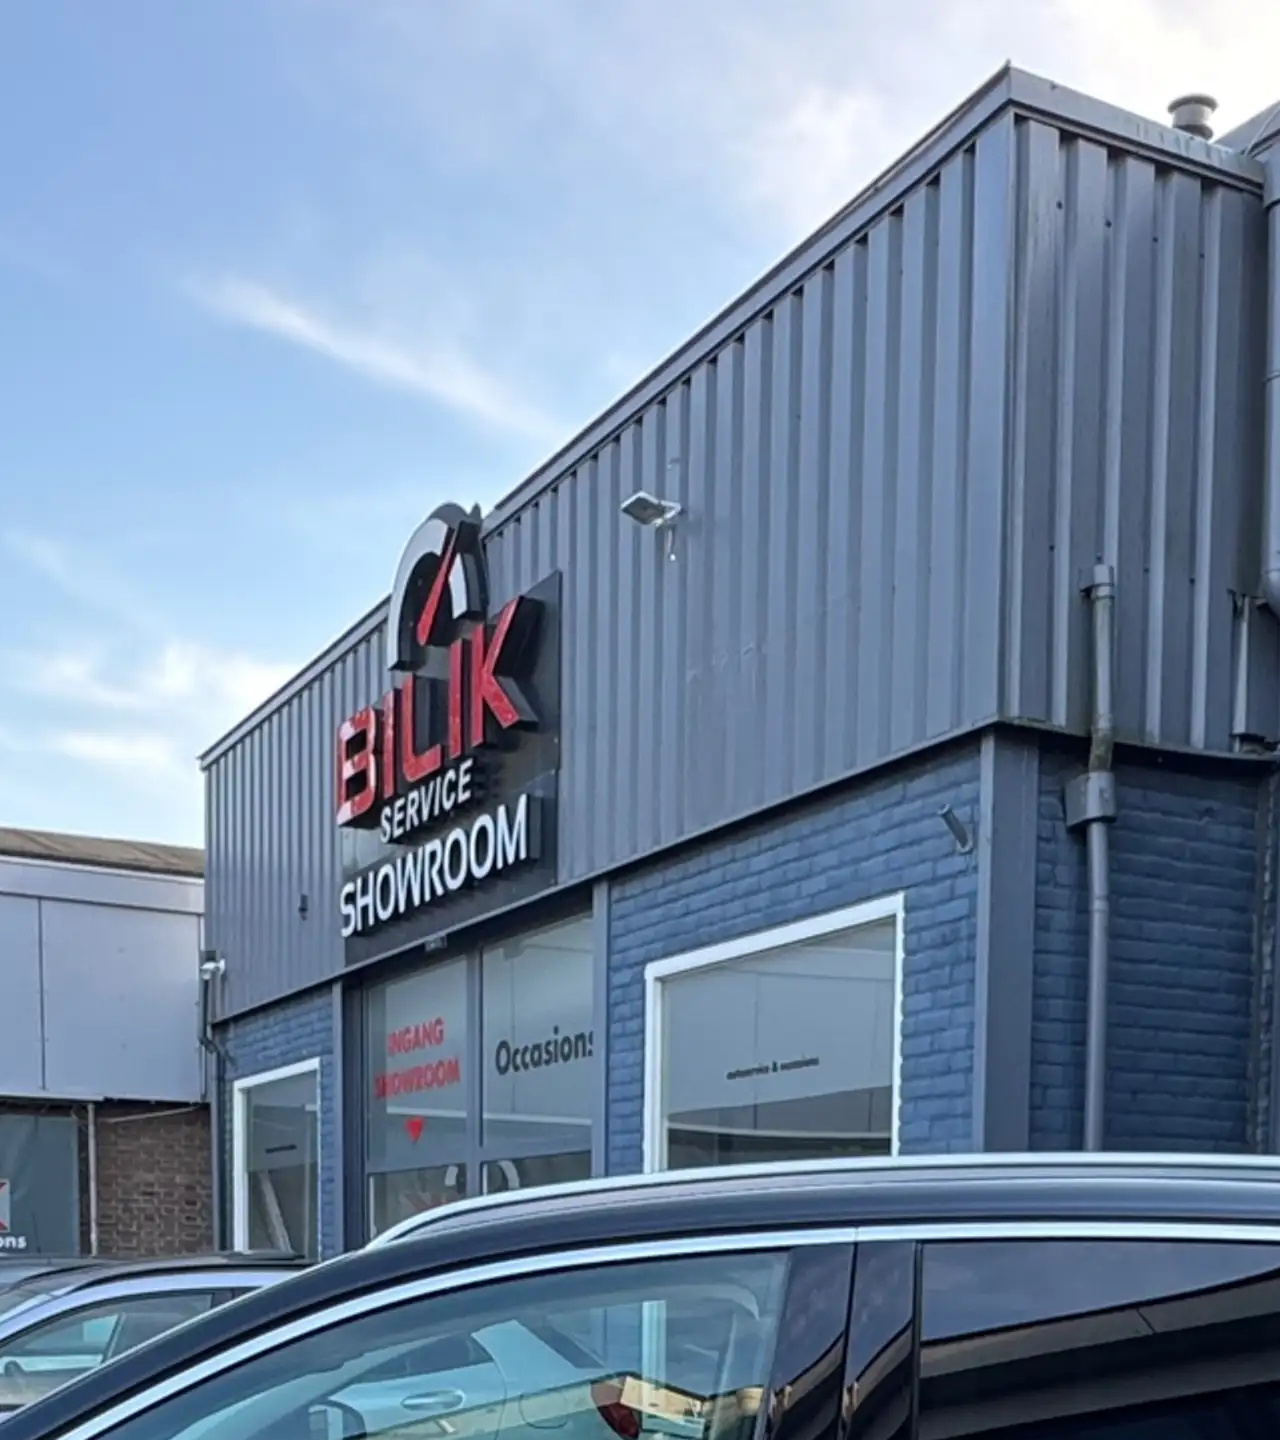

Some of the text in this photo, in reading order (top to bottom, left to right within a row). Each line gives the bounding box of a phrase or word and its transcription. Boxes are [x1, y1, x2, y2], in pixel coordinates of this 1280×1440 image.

[336, 593, 522, 828] BILIK
[379, 758, 473, 846] SERVICE
[339, 793, 528, 938] SHOWROOM
[375, 1057, 461, 1098] SHOWROOM
[387, 1017, 444, 1056] INGANG
